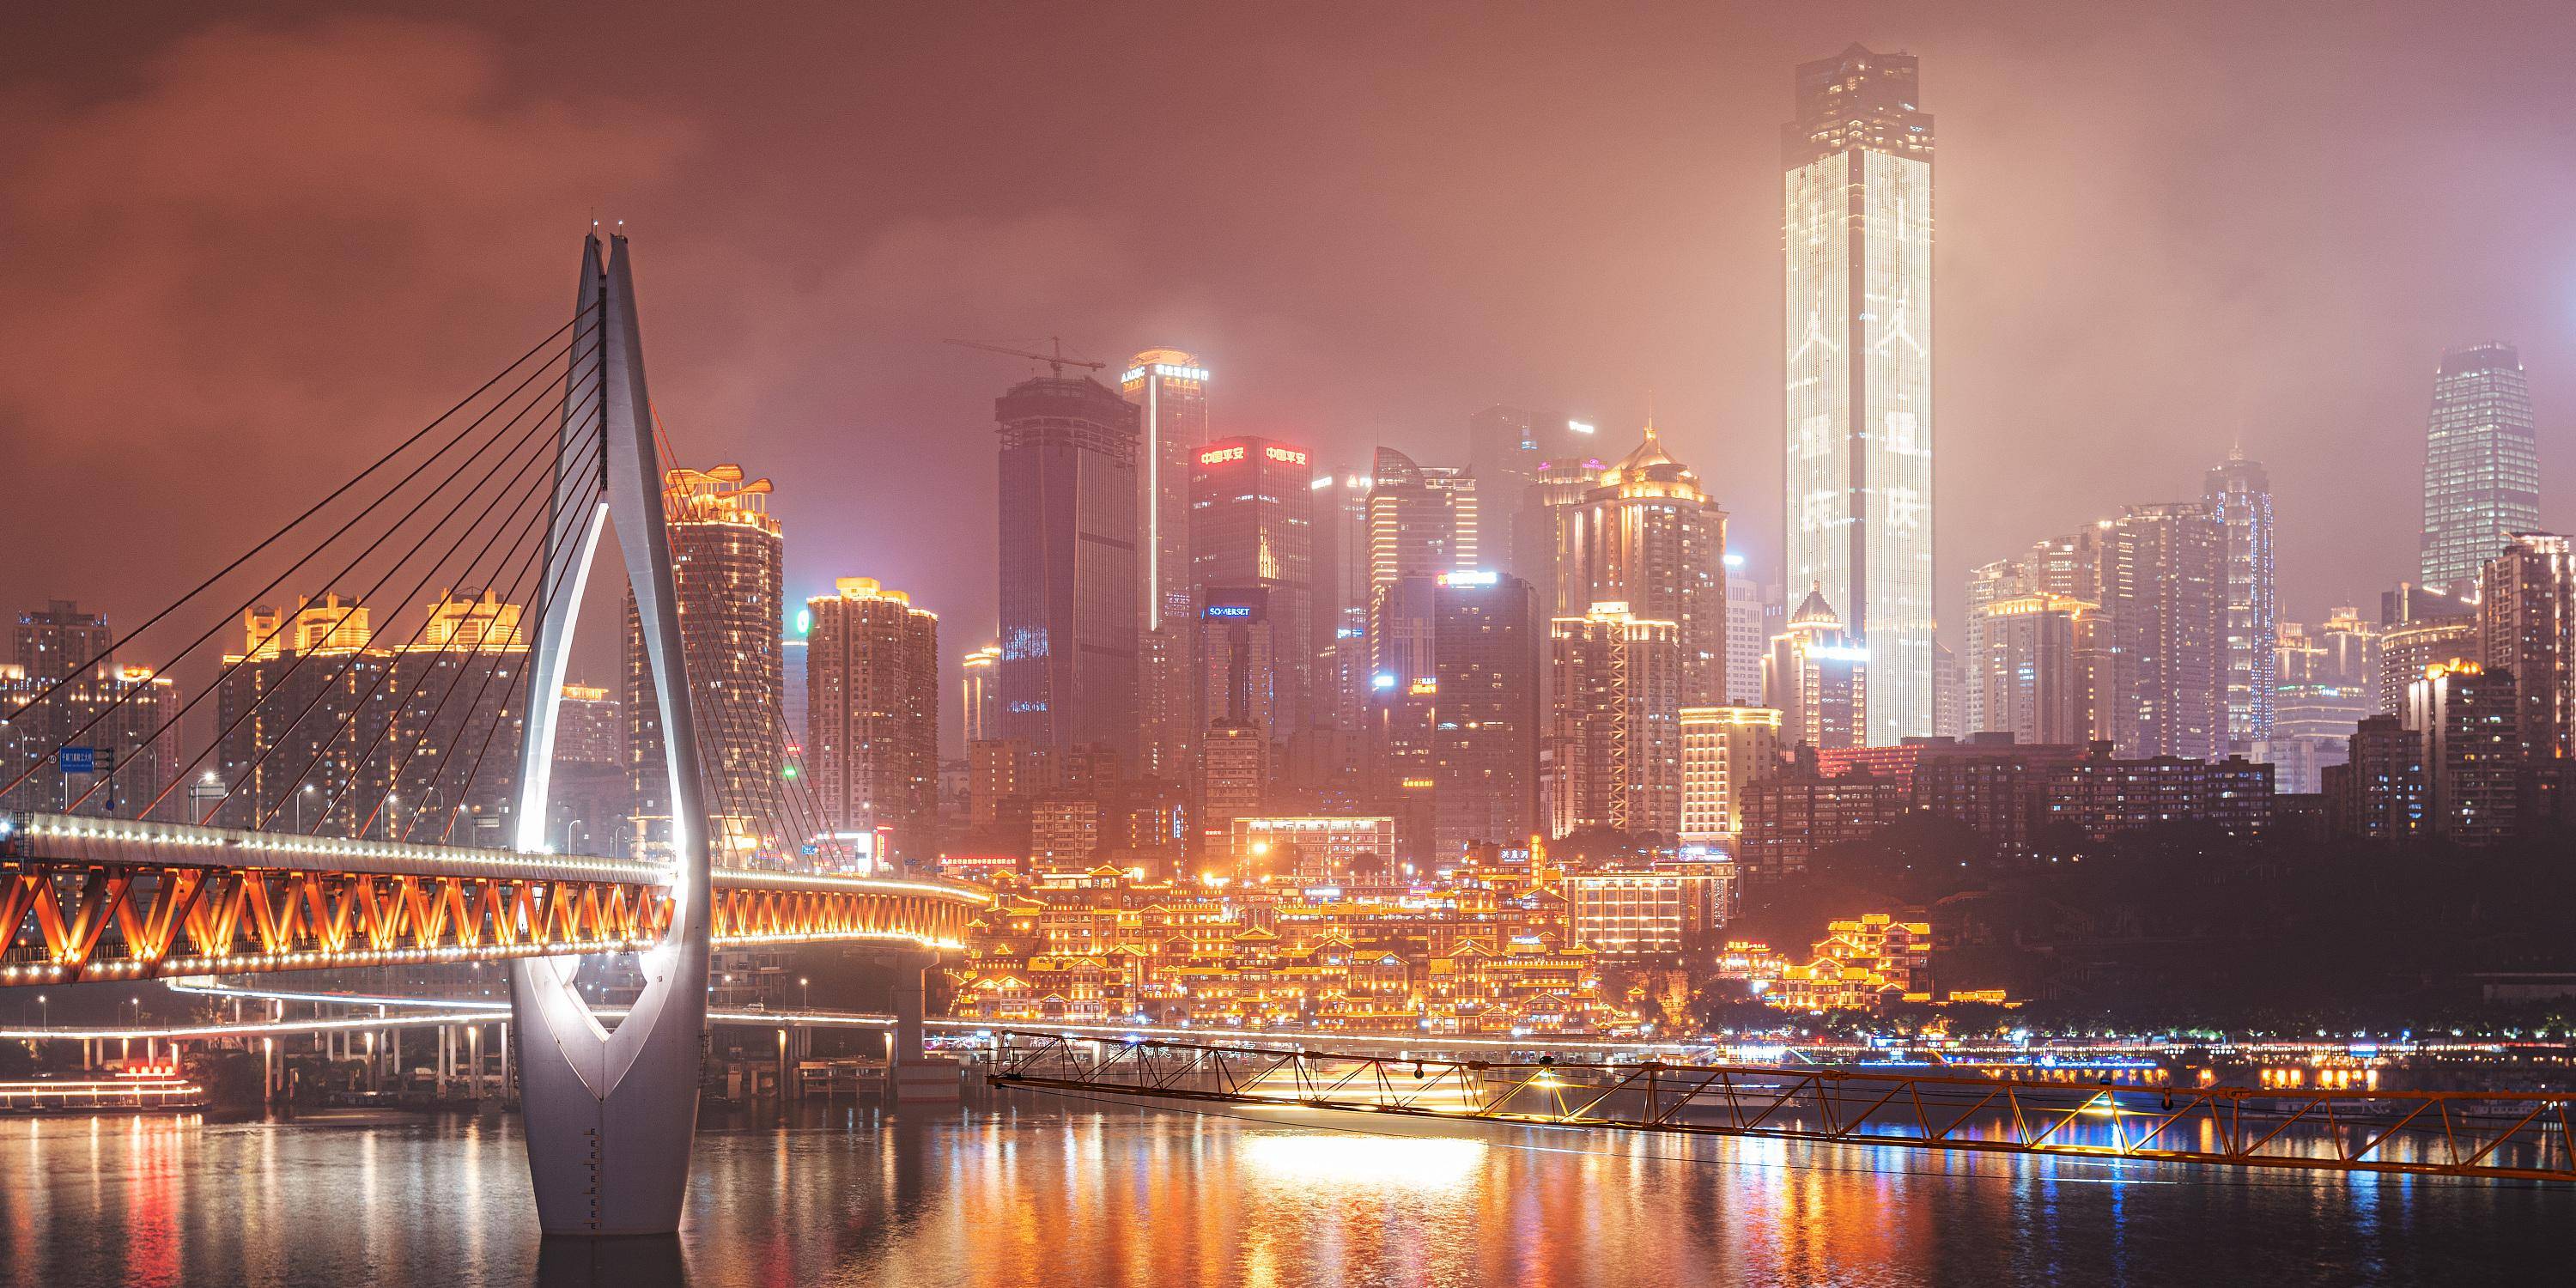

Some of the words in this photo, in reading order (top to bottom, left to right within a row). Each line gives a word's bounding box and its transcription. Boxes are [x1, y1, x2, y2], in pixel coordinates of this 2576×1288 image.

[1201, 447, 1244, 465] 中国平安
[1266, 447, 1305, 465] 中国平安
[1209, 607, 1249, 616] SOMERSET
[1501, 850, 1528, 859] 洪崖洞
